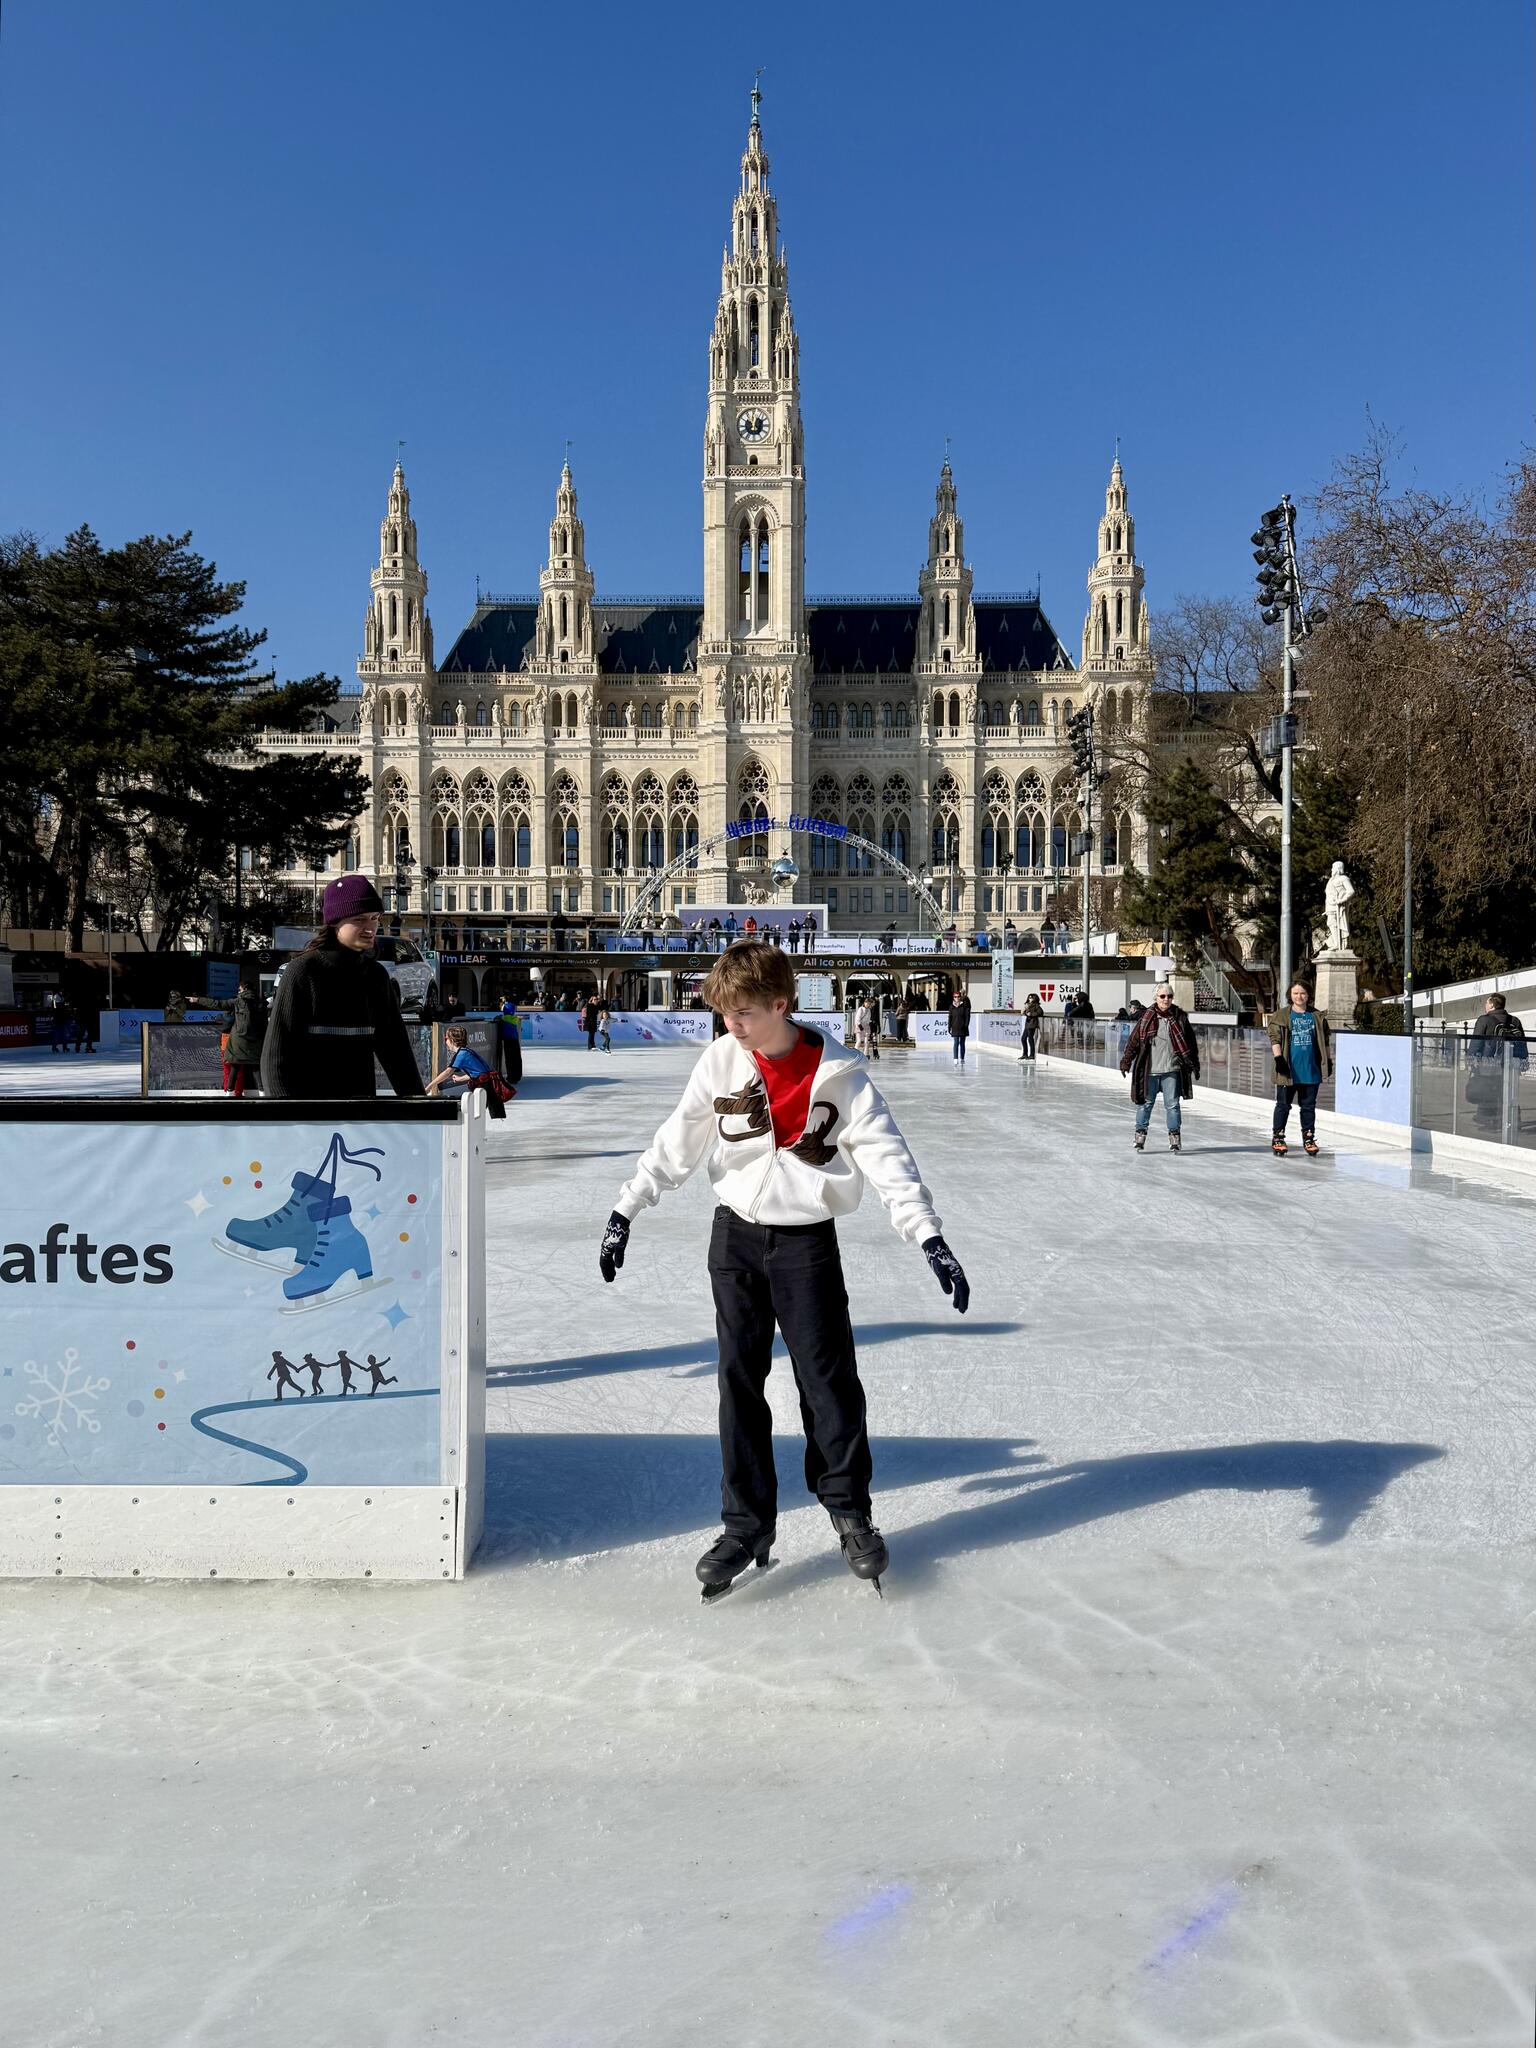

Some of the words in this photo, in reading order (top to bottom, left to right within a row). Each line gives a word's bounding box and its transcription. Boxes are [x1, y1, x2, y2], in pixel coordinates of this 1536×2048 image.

[441, 954, 458, 963] I'm
[460, 954, 488, 964] LEAF.
[803, 958, 817, 967] All
[819, 958, 834, 967] Ice
[836, 959, 851, 967] on
[853, 958, 891, 967] MICRA.
[1059, 983, 1084, 993] Stad
[663, 1017, 695, 1027] Ausgang
[0, 1222, 174, 1285] aftes
